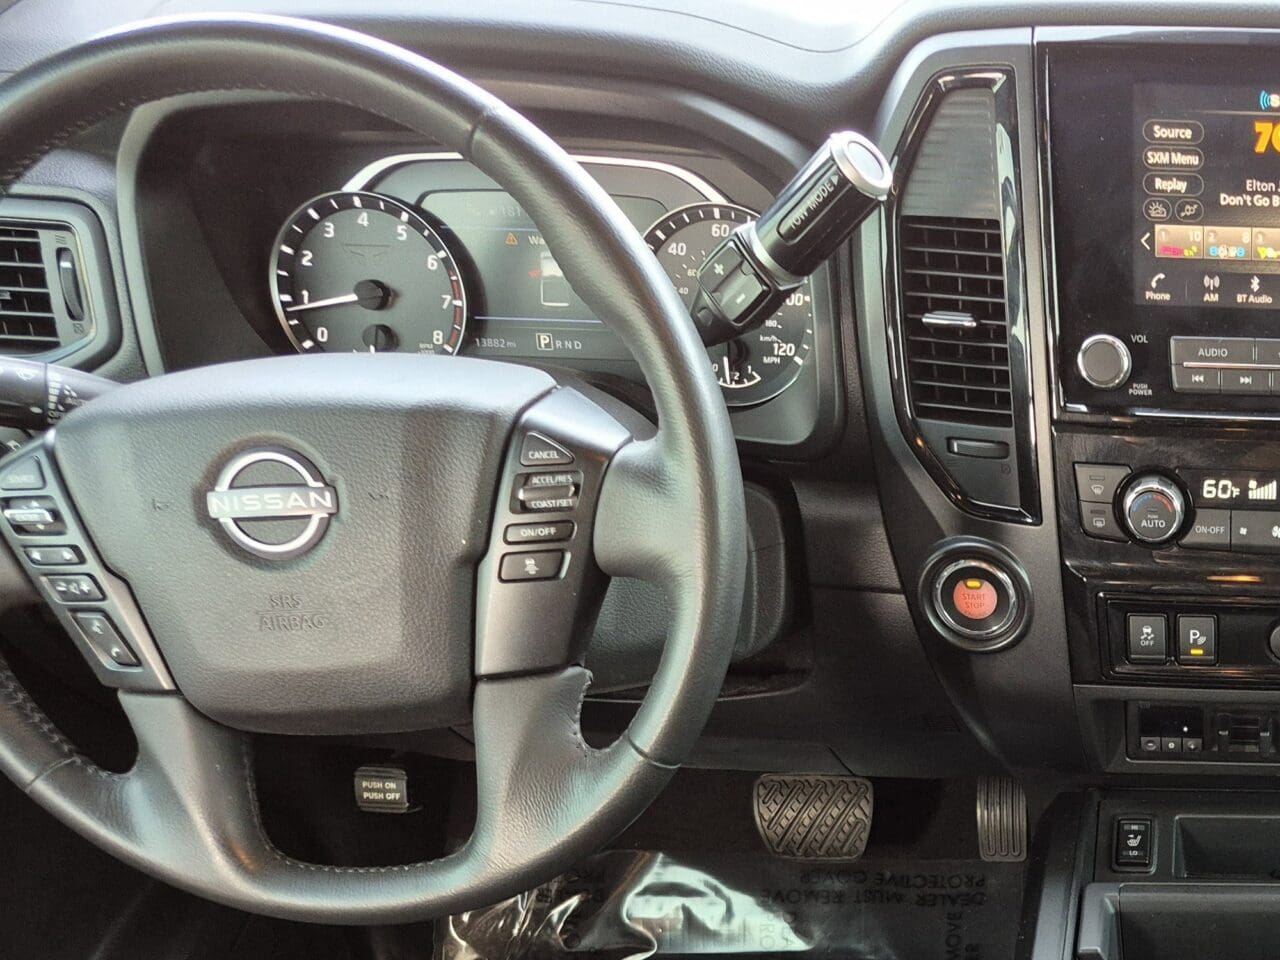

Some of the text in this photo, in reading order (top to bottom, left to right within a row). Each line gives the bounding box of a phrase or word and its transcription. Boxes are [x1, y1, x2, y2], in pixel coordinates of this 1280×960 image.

[1153, 125, 1192, 140] Source
[1147, 151, 1199, 166] SXM Menu
[1154, 177, 1188, 193] Replay
[1246, 179, 1276, 193] Elton
[807, 183, 835, 211] MODE
[1220, 193, 1251, 206] Don't
[1253, 194, 1270, 207] Go
[357, 212, 369, 227] 4
[323, 222, 335, 238] 3
[396, 225, 408, 241] 5
[711, 224, 730, 237] 60
[668, 243, 687, 256] 40
[301, 251, 313, 266] 2
[427, 254, 438, 270] 6
[441, 295, 452, 310] 7
[1145, 291, 1171, 301] Phone
[1203, 293, 1219, 303] AM
[1236, 293, 1273, 304] BT Audio
[316, 327, 328, 342] 0
[432, 330, 444, 345] 8
[1131, 335, 1149, 344] VOL
[540, 335, 550, 348] P
[773, 343, 796, 356] 120
[1198, 348, 1228, 358] AUDIO
[528, 450, 560, 460] CANCEL
[212, 491, 333, 514] NISSAN
[531, 499, 573, 508] COAST/SET
[1141, 519, 1166, 529] AUTO
[1194, 525, 1225, 535] ON-OFF
[520, 527, 557, 537] ON/OFF
[258, 615, 326, 632] AIRBAG
[1140, 639, 1155, 647] OFF
[362, 780, 383, 789] PUSH
[363, 791, 401, 800] PUSH OFF
